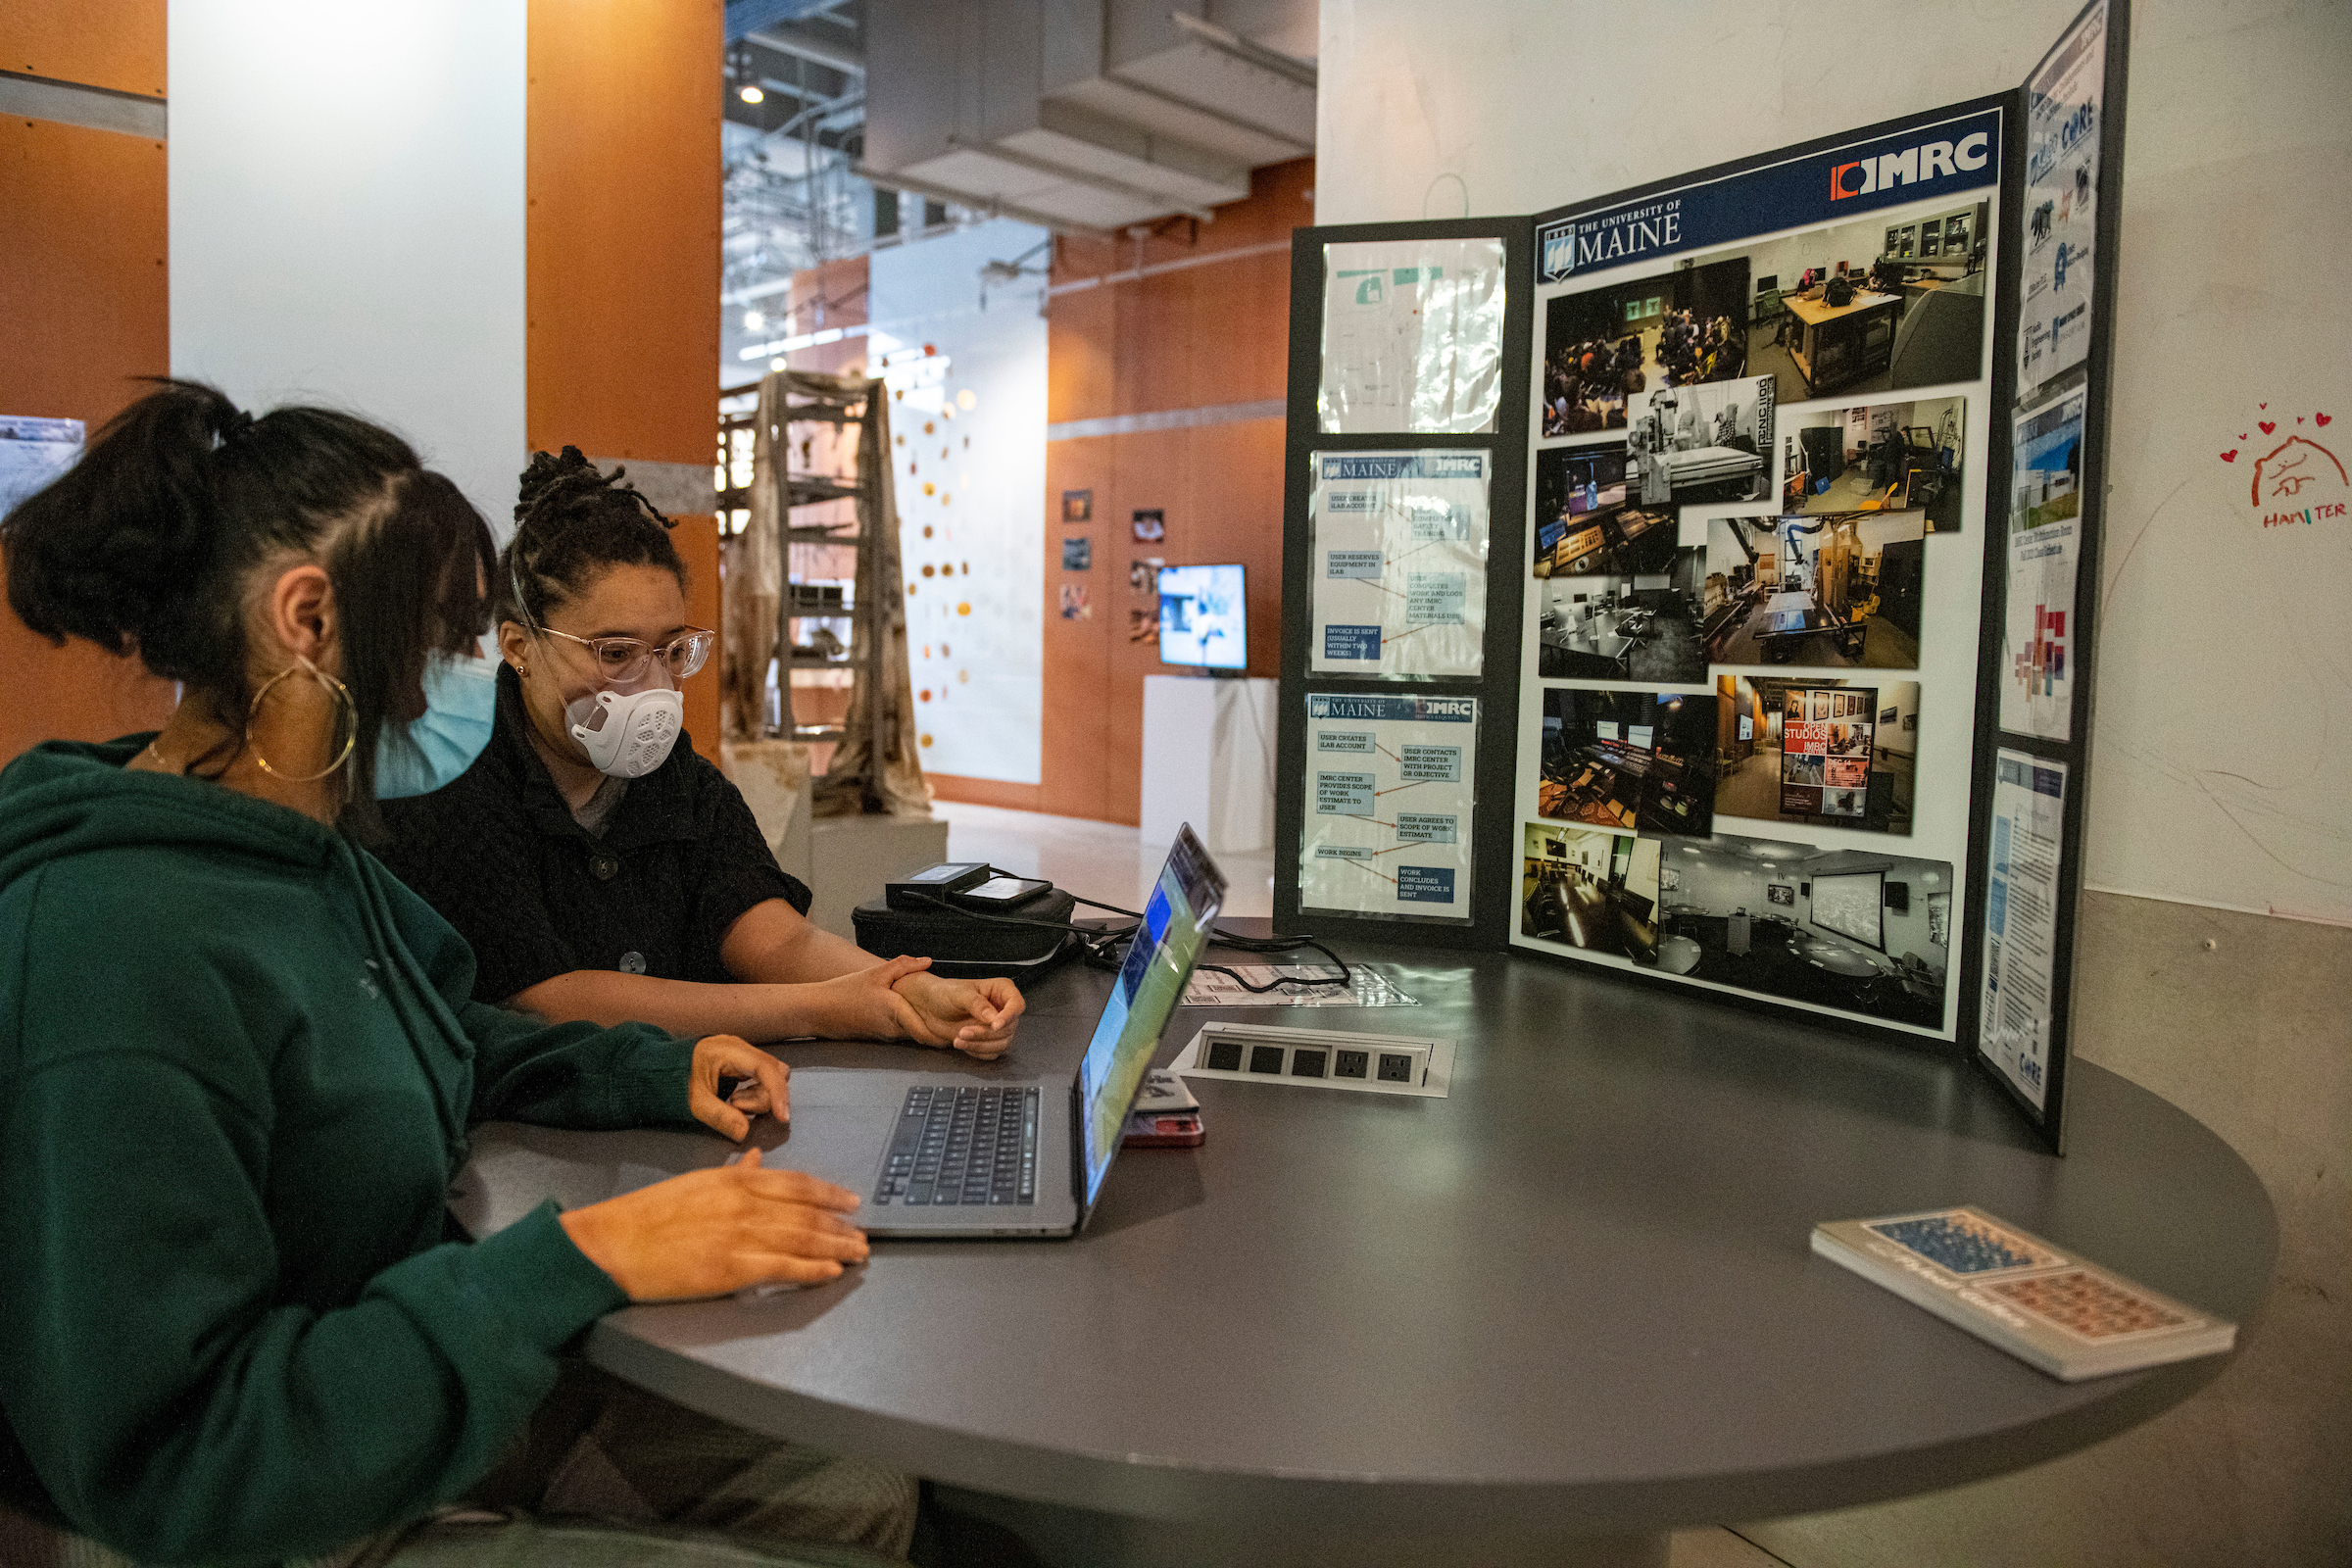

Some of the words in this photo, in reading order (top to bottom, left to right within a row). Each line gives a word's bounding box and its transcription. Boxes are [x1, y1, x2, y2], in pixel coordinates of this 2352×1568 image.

[1860, 131, 1988, 195] IMRC
[1579, 220, 1599, 235] THE
[1601, 204, 1664, 229] UNIVERSITY
[1666, 199, 1682, 212] OF
[1577, 212, 1683, 267] MAINE
[1343, 463, 1396, 476] MAINE
[1330, 703, 1387, 717] MAINE
[1426, 702, 1472, 715] IMRC
[1803, 722, 1828, 731] OPEN
[1784, 728, 1827, 740] STUDIOS
[1803, 741, 1827, 751] IMRC
